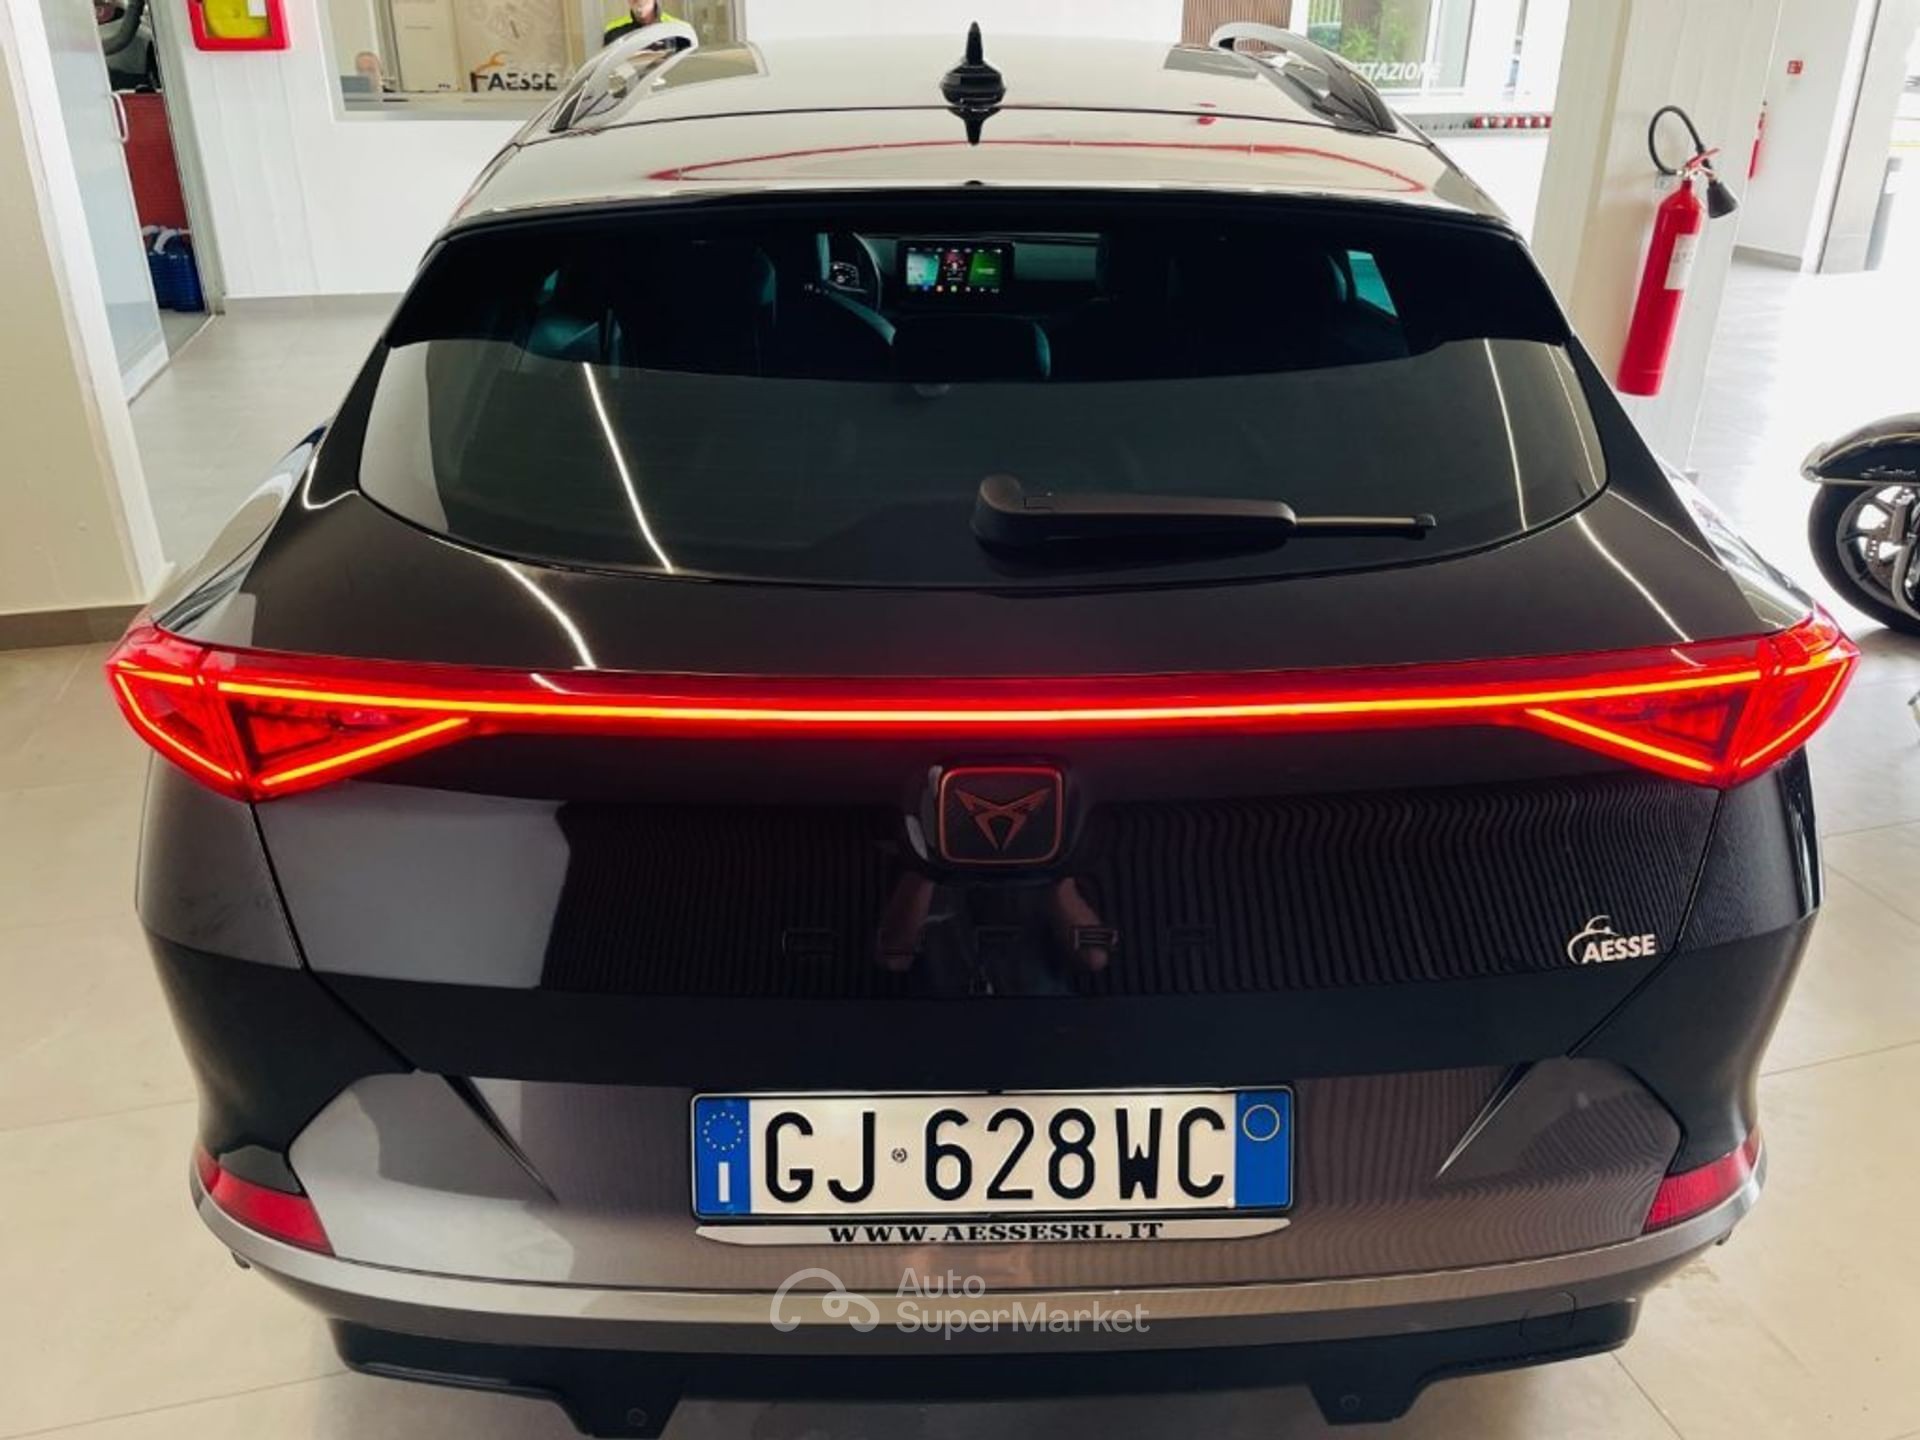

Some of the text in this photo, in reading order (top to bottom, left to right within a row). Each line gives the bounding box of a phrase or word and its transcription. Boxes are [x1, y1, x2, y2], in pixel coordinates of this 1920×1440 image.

[1582, 933, 1656, 964] AESSE
[765, 1107, 1226, 1203] GJ 628WC
[829, 1222, 1163, 1242] WWW.AESSESRL.IT
